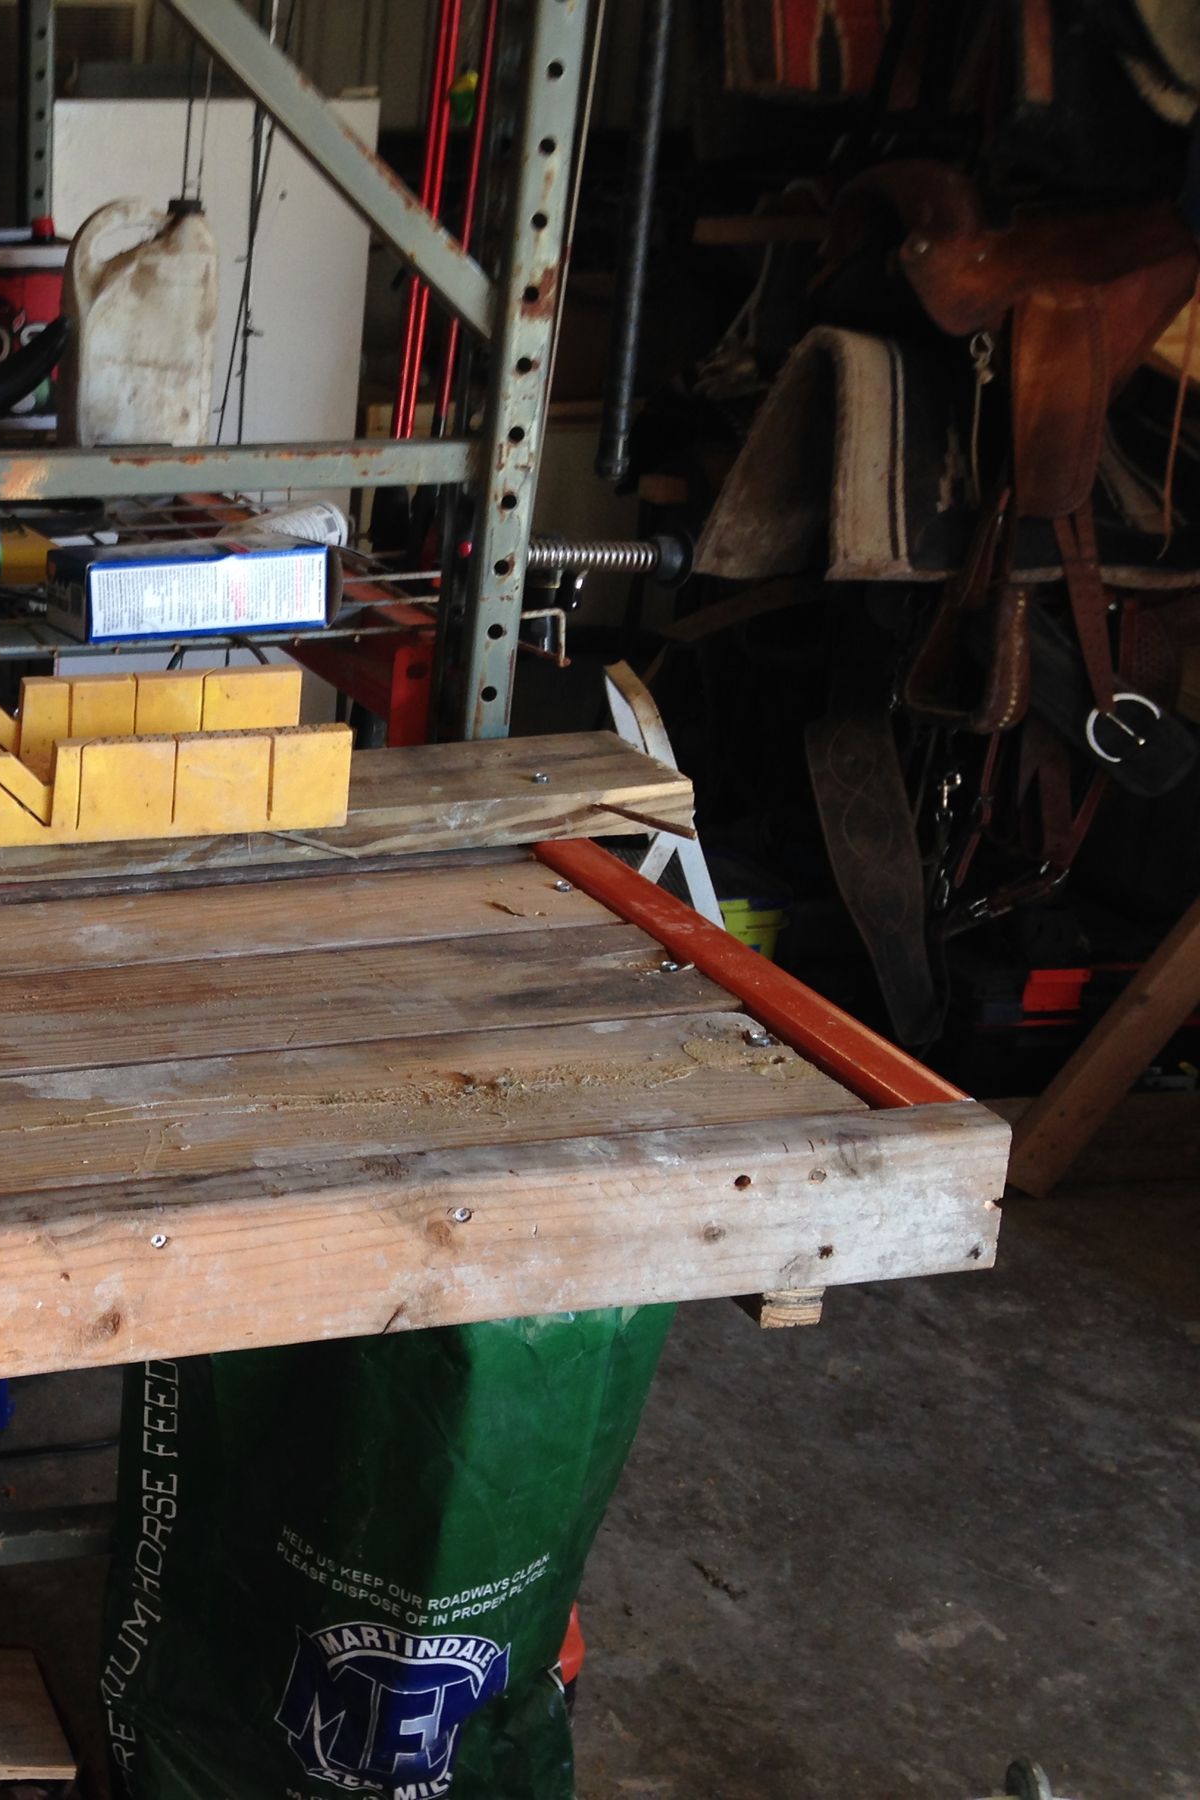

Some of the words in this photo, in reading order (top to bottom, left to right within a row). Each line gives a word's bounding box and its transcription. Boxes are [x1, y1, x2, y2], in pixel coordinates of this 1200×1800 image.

[131, 1468, 179, 1601] HORSE
[282, 1524, 314, 1556] HELP
[316, 1553, 337, 1573] US
[340, 1566, 385, 1589] KEEP
[388, 1583, 424, 1610] OUR
[427, 1577, 510, 1612] ROADWAYS
[276, 1541, 329, 1585] PLEASE
[331, 1578, 402, 1618] DISPOSE
[404, 1610, 429, 1628] OF
[432, 1613, 449, 1628] IN
[451, 1591, 508, 1623] PROPER
[317, 1625, 501, 1670] MARTINDALE
